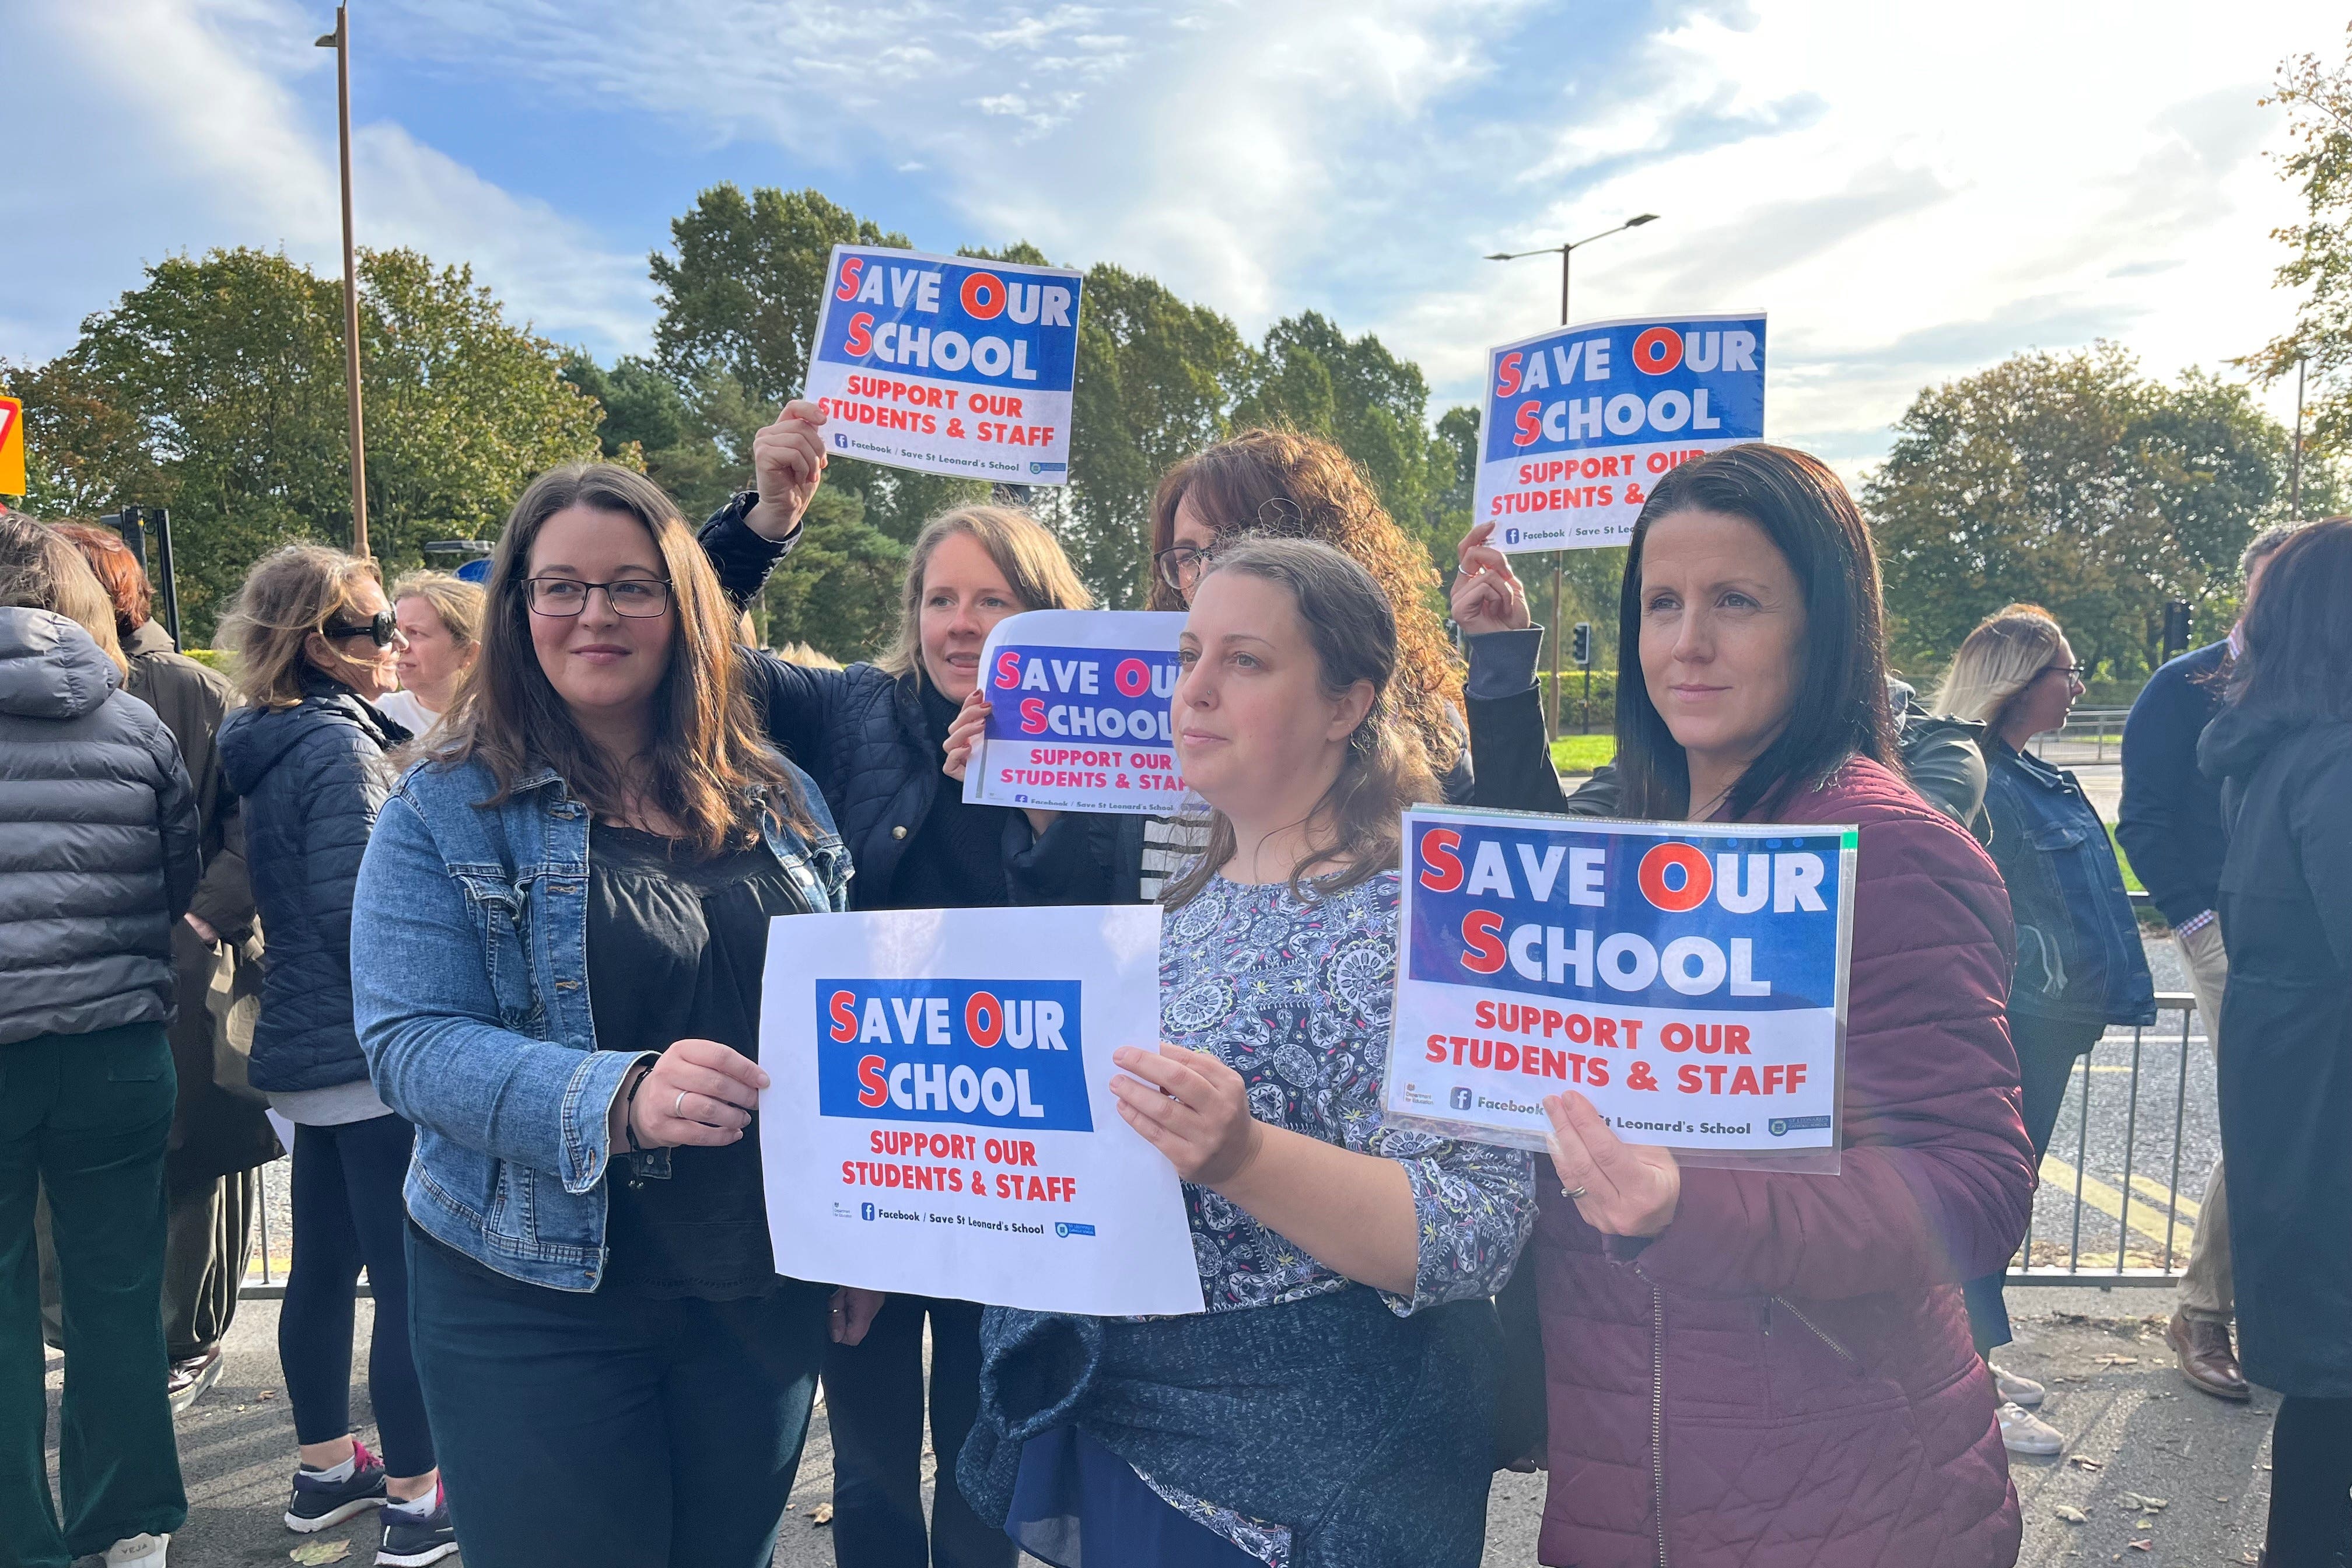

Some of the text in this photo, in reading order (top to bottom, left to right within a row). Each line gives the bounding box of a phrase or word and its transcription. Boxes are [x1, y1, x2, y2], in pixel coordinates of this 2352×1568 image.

[835, 257, 1072, 327] SAVE OUR
[844, 312, 1037, 381] SCHOOL
[1496, 327, 1758, 398] SAVE OUR
[847, 374, 1023, 418] SUPPORT OUR
[1513, 388, 1720, 446] SCHOOL
[818, 397, 1054, 447] STUDENTS & STAFF
[851, 440, 891, 454] Facebook
[901, 449, 923, 460] Save
[926, 453, 935, 461] St
[939, 454, 986, 468] Leonard's
[989, 461, 1019, 471] School
[1519, 454, 1635, 485] SUPPORT
[1491, 482, 1644, 516] STUDENTS &
[1523, 528, 1564, 540] Facebook
[1576, 527, 1601, 536] Save
[994, 652, 1180, 700] SAVE OU
[1020, 698, 1172, 741] SCHOOL
[1000, 769, 1186, 792] STUDENTS & STAF
[1030, 748, 1172, 770] SUPPORT OUR
[1031, 799, 1068, 807] Facebook
[1419, 828, 1828, 914] SAVE OUR
[1460, 908, 1771, 997] SCHOOL
[830, 990, 1069, 1051] SAVE OUR
[1474, 1000, 1752, 1055] SUPPORT OUR
[1425, 1034, 1807, 1095] STUDENTS & STAFF
[857, 1055, 1045, 1118] SCHOOL
[1478, 1096, 1544, 1115] Facebook
[1618, 1116, 1693, 1133] Leonard's
[1700, 1123, 1751, 1135] School
[870, 1129, 1038, 1167] SUPPORT OUR
[841, 1161, 1076, 1203] STUDENTS & STAFF
[878, 1209, 920, 1222] Facebook
[929, 1213, 954, 1224] Save
[957, 1215, 965, 1224] St
[968, 1216, 1009, 1231] Leonard's
[1012, 1223, 1044, 1234] School
[121, 1543, 148, 1555] VEJA
